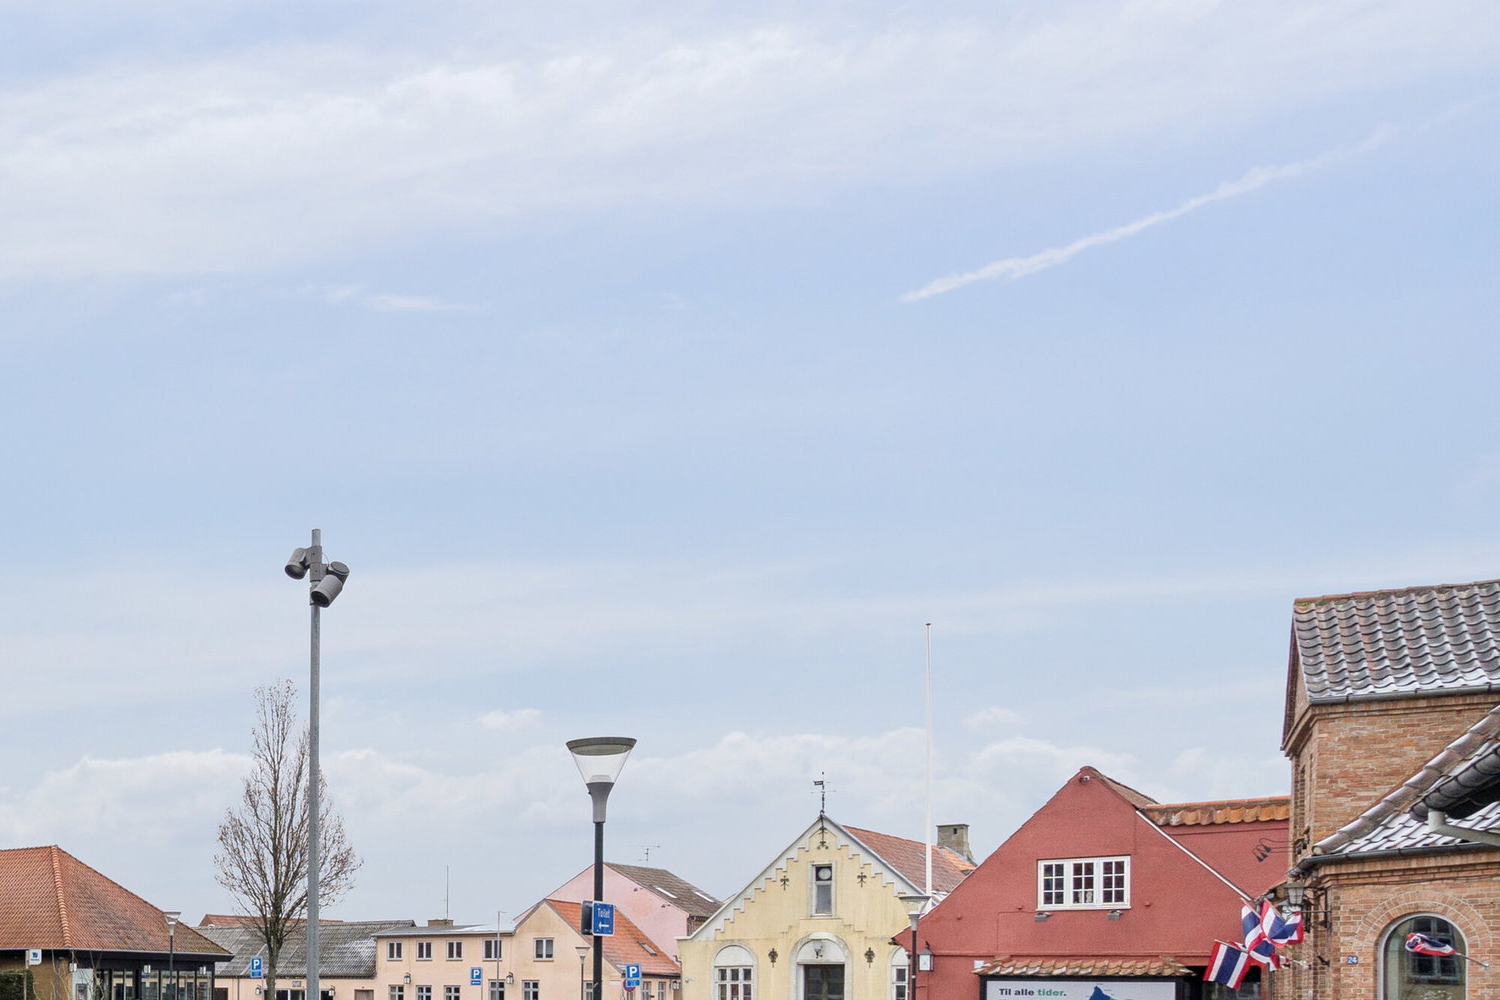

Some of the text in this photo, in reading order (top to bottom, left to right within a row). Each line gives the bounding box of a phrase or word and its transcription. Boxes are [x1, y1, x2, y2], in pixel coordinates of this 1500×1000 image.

[253, 959, 260, 970] P
[1347, 956, 1357, 964] 24
[473, 969, 480, 979] P
[629, 966, 638, 978] P
[999, 988, 1067, 997] Til alle tider.
